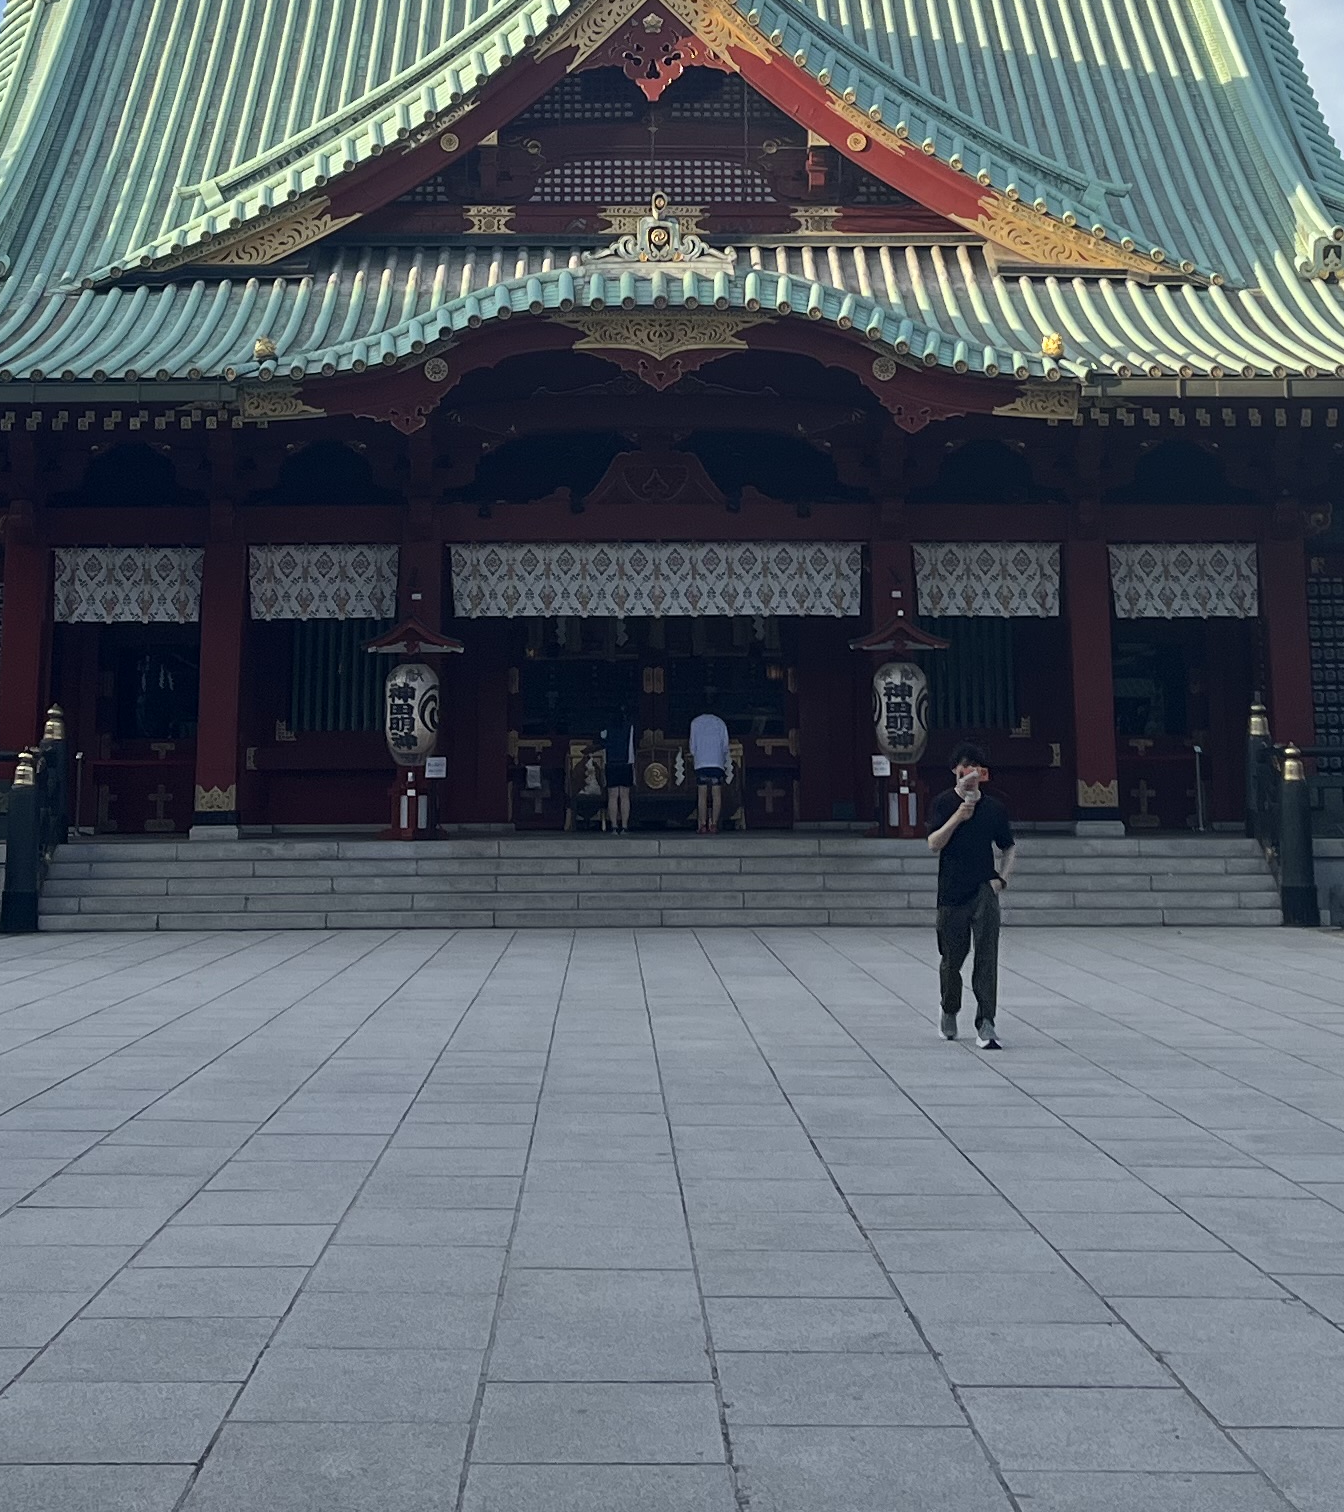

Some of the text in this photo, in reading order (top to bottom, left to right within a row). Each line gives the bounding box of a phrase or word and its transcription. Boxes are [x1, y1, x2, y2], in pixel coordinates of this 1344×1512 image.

[389, 682, 418, 750] 神田明神
[883, 682, 915, 749] 神田明神
